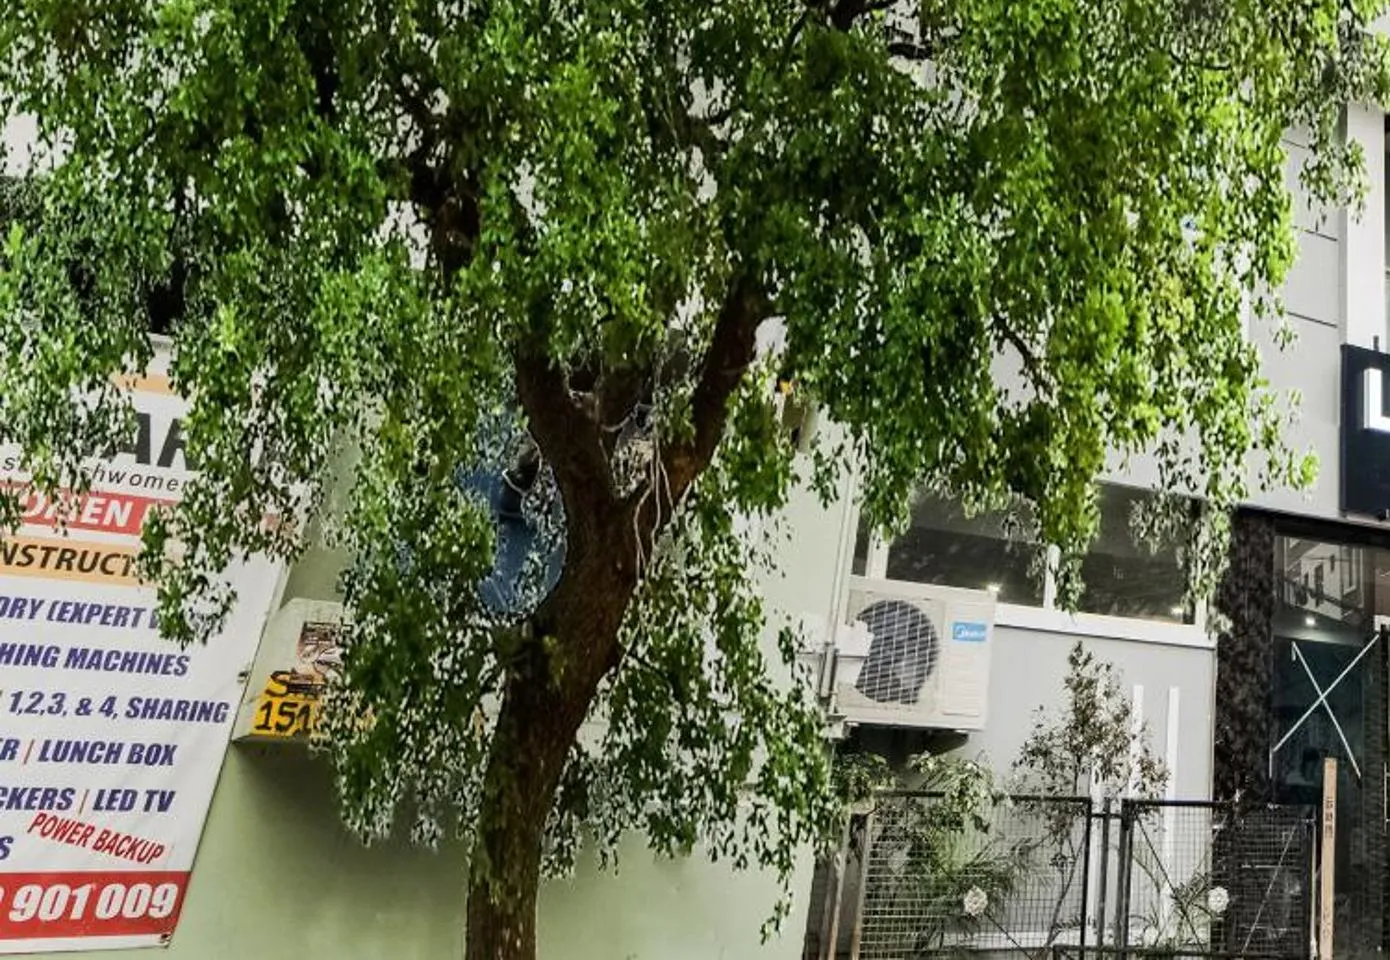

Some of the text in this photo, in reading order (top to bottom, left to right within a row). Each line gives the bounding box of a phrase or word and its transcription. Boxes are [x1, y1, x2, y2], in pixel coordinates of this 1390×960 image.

[63, 647, 191, 677] MACHINES
[75, 697, 93, 717] &
[125, 696, 230, 723] SHARING
[38, 740, 125, 765] LUNCH
[127, 743, 178, 766] BOX
[92, 789, 139, 813] LED
[143, 790, 176, 813] TV
[27, 812, 165, 865] POWER BACKUP
